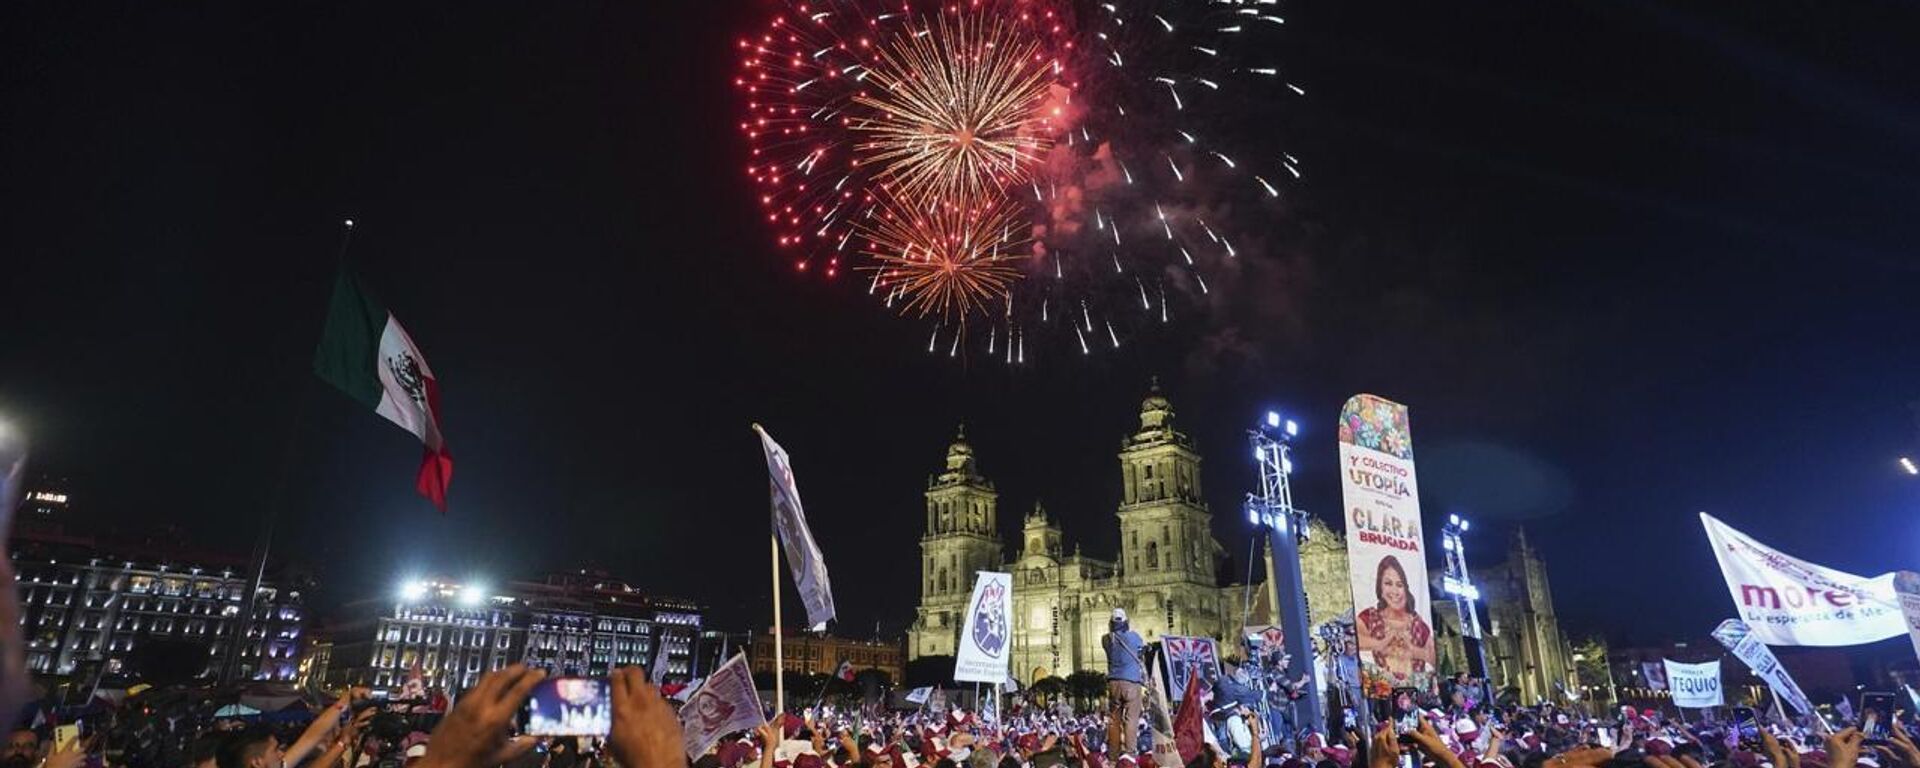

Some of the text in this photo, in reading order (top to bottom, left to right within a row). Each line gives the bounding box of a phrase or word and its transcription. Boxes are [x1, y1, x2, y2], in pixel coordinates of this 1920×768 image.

[1352, 507, 1419, 539] CLARA
[1359, 531, 1419, 552] BRUGADA
[1766, 612, 1831, 626] espeza
[1672, 676, 1718, 696] TEQUIO
